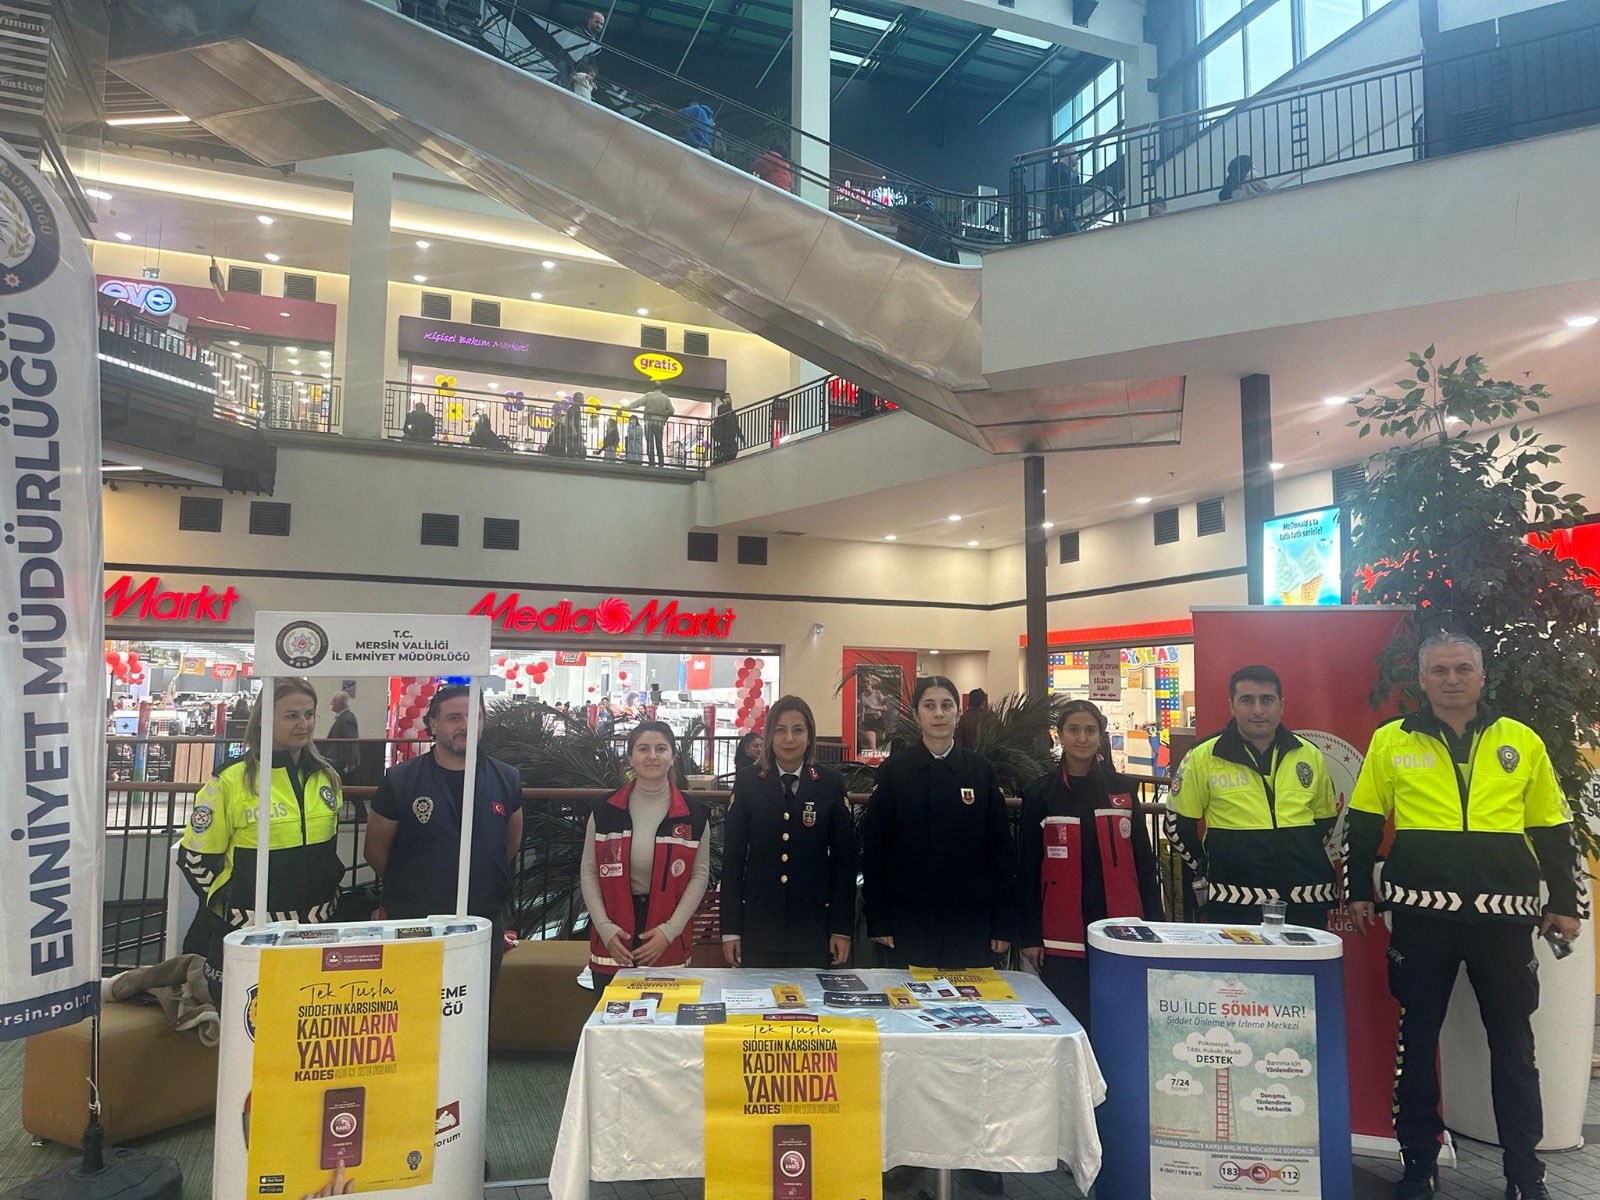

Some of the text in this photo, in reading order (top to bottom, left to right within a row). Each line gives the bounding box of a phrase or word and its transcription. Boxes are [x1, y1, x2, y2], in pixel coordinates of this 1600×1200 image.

[0, 79, 44, 93] eative
[0, 158, 53, 236] DÜRLÜĞÜ
[424, 331, 529, 352] Kişisel Bakım Marketi
[640, 357, 677, 372] gratis
[0, 312, 69, 695] MÜDÜRLÜĞÜ
[104, 575, 240, 622] Markt
[469, 592, 736, 638] Media Markt
[393, 630, 413, 639] T.C.
[355, 640, 449, 650] MERSİN VALİLİĞİ
[332, 652, 471, 662] İL EMNİYET MÜDÜRLÜĞÜ
[1393, 752, 1435, 769] POLİS
[1210, 772, 1249, 790] POLİS
[244, 801, 288, 824] POİS
[11, 712, 75, 976] EMNİYET
[300, 978, 395, 1004] Tek Tuşla
[0, 994, 91, 1026] rsin.pol.tr
[1160, 999, 1305, 1019] BU İLDE ŞÖNİM VAR!
[297, 1013, 399, 1040] KADINLARIN
[744, 1024, 834, 1039] Tek Tuşla
[1166, 1016, 1192, 1025] Şiddet
[1226, 1020, 1236, 1028] ve
[1267, 1021, 1299, 1030] Merkezi
[297, 1035, 396, 1069] YANINDA
[743, 1039, 783, 1053] ŞİDDETİN
[743, 1052, 838, 1074] KADINLARIN
[1196, 1055, 1233, 1064] DESTEK
[294, 1069, 334, 1081] KADES
[1171, 1078, 1190, 1086] 7/24
[744, 1074, 838, 1103] YANINDA
[743, 1105, 780, 1115] KADES
[1222, 1167, 1238, 1176] 183
[1282, 1171, 1298, 1179] 112
